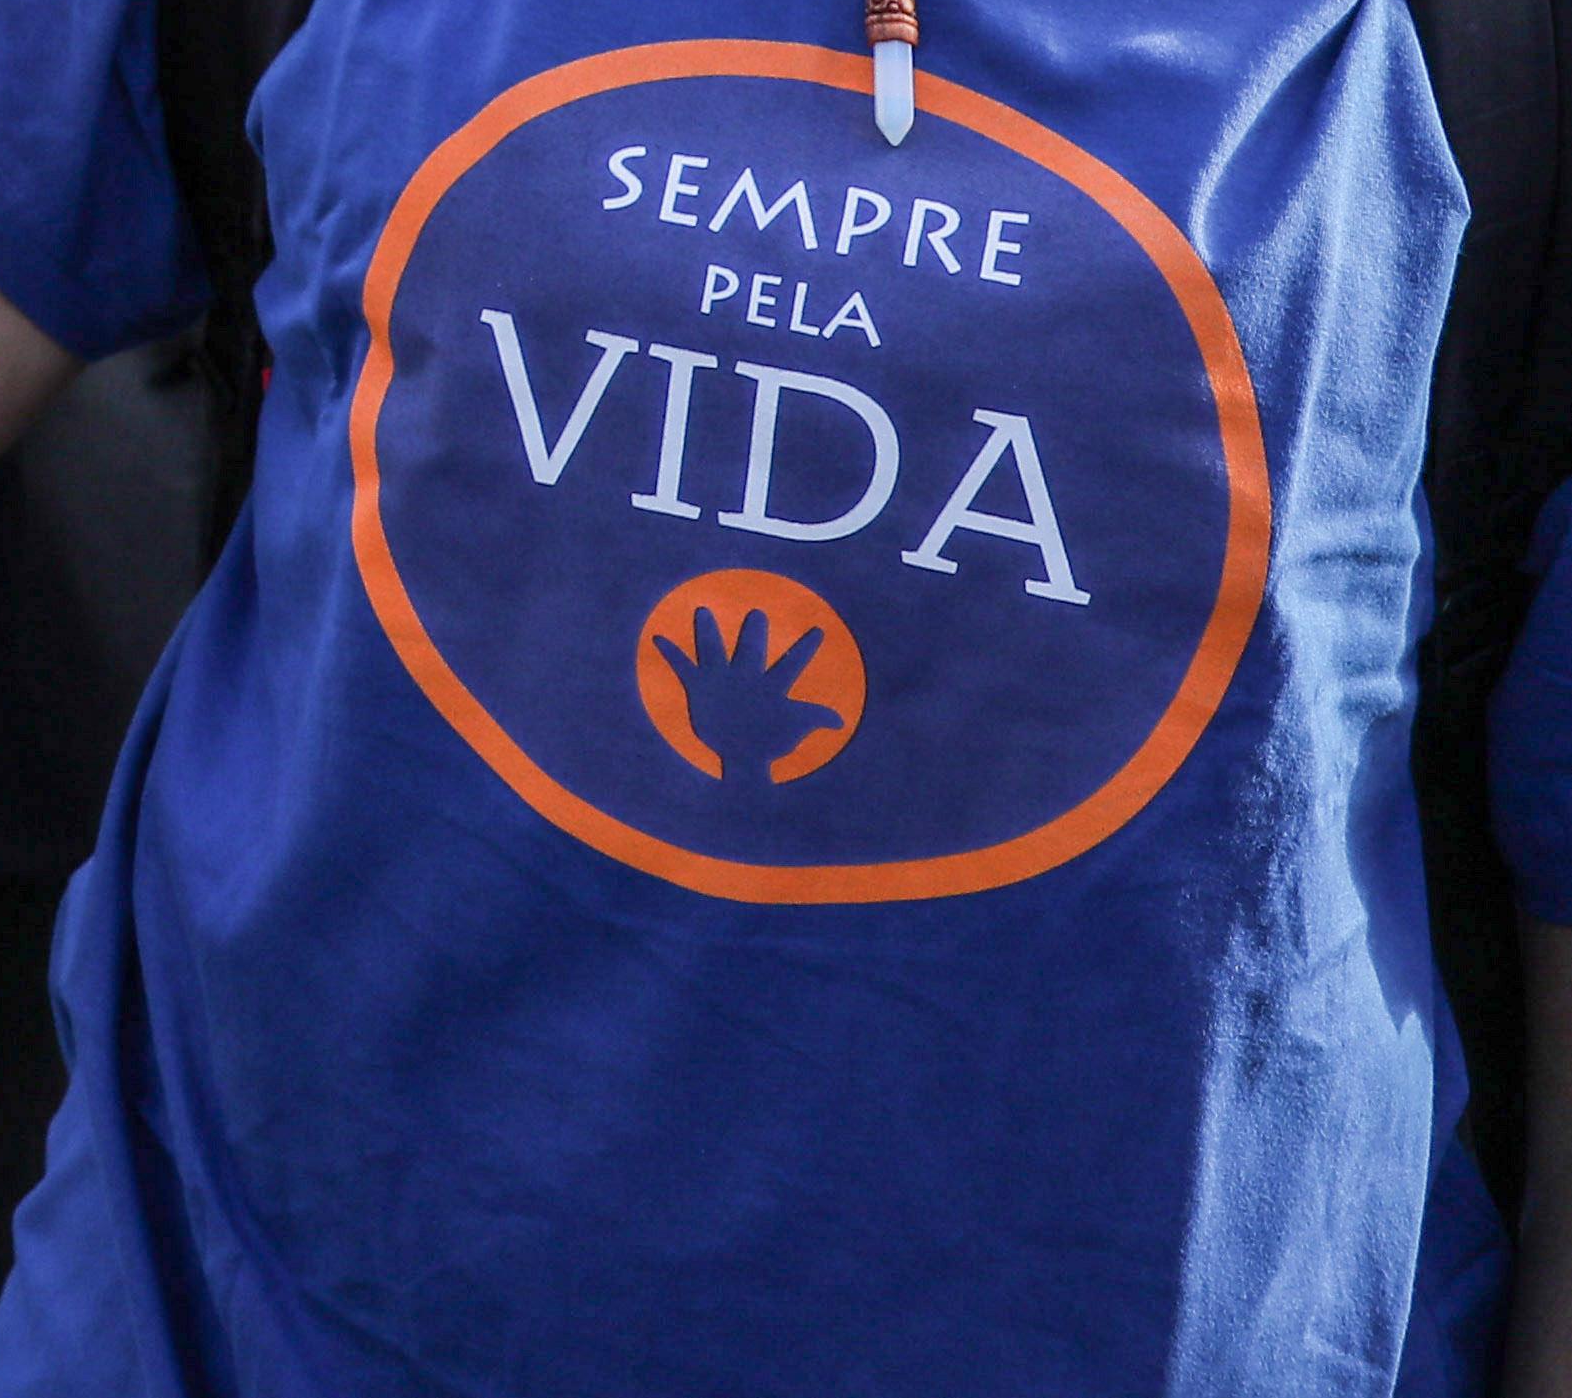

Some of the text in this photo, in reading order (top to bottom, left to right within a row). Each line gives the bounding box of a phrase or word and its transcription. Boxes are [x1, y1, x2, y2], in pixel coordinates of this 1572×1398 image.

[601, 145, 1031, 287] SEMPRE
[699, 263, 882, 348] PELA
[479, 308, 1092, 606] VIDA
